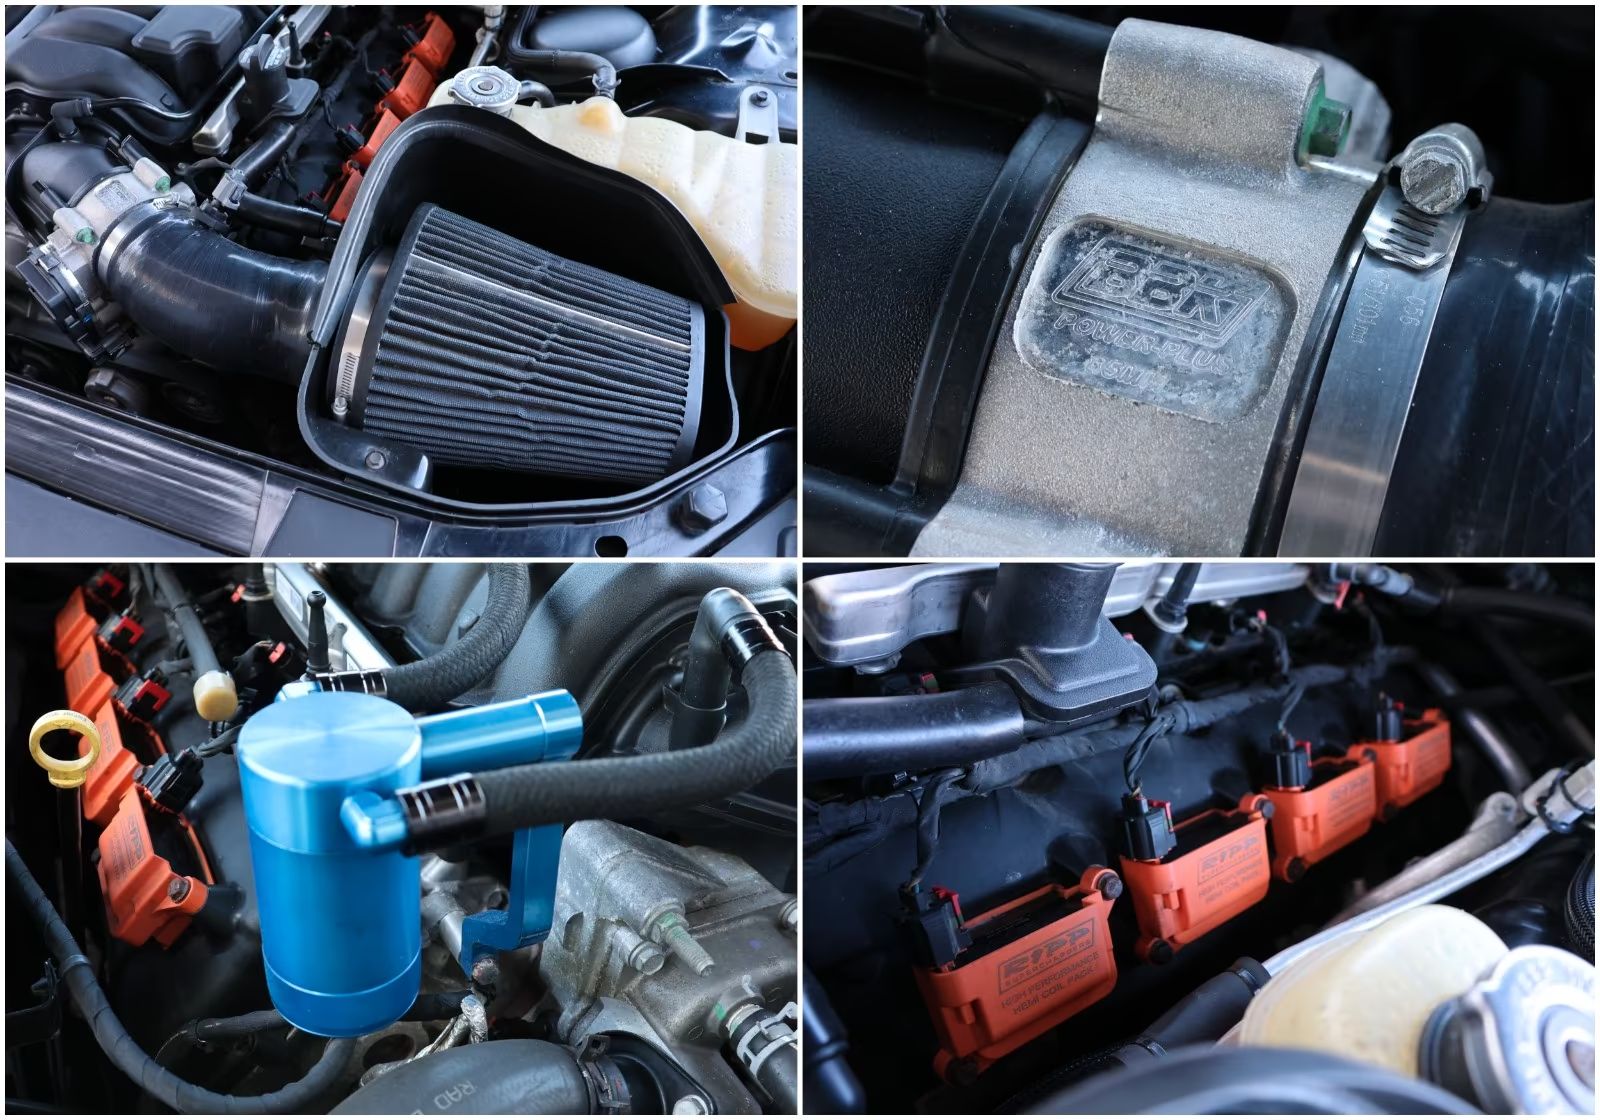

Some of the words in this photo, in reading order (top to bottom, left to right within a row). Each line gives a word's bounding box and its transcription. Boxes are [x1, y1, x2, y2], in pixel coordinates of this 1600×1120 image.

[1003, 928, 1090, 977] RIPP
[1001, 989, 1027, 1008] HIGH
[1028, 951, 1100, 993] PERFORMANCE
[1012, 994, 1040, 1014] HEMI
[1041, 981, 1064, 999] COIL
[434, 1080, 475, 1109] RAD
